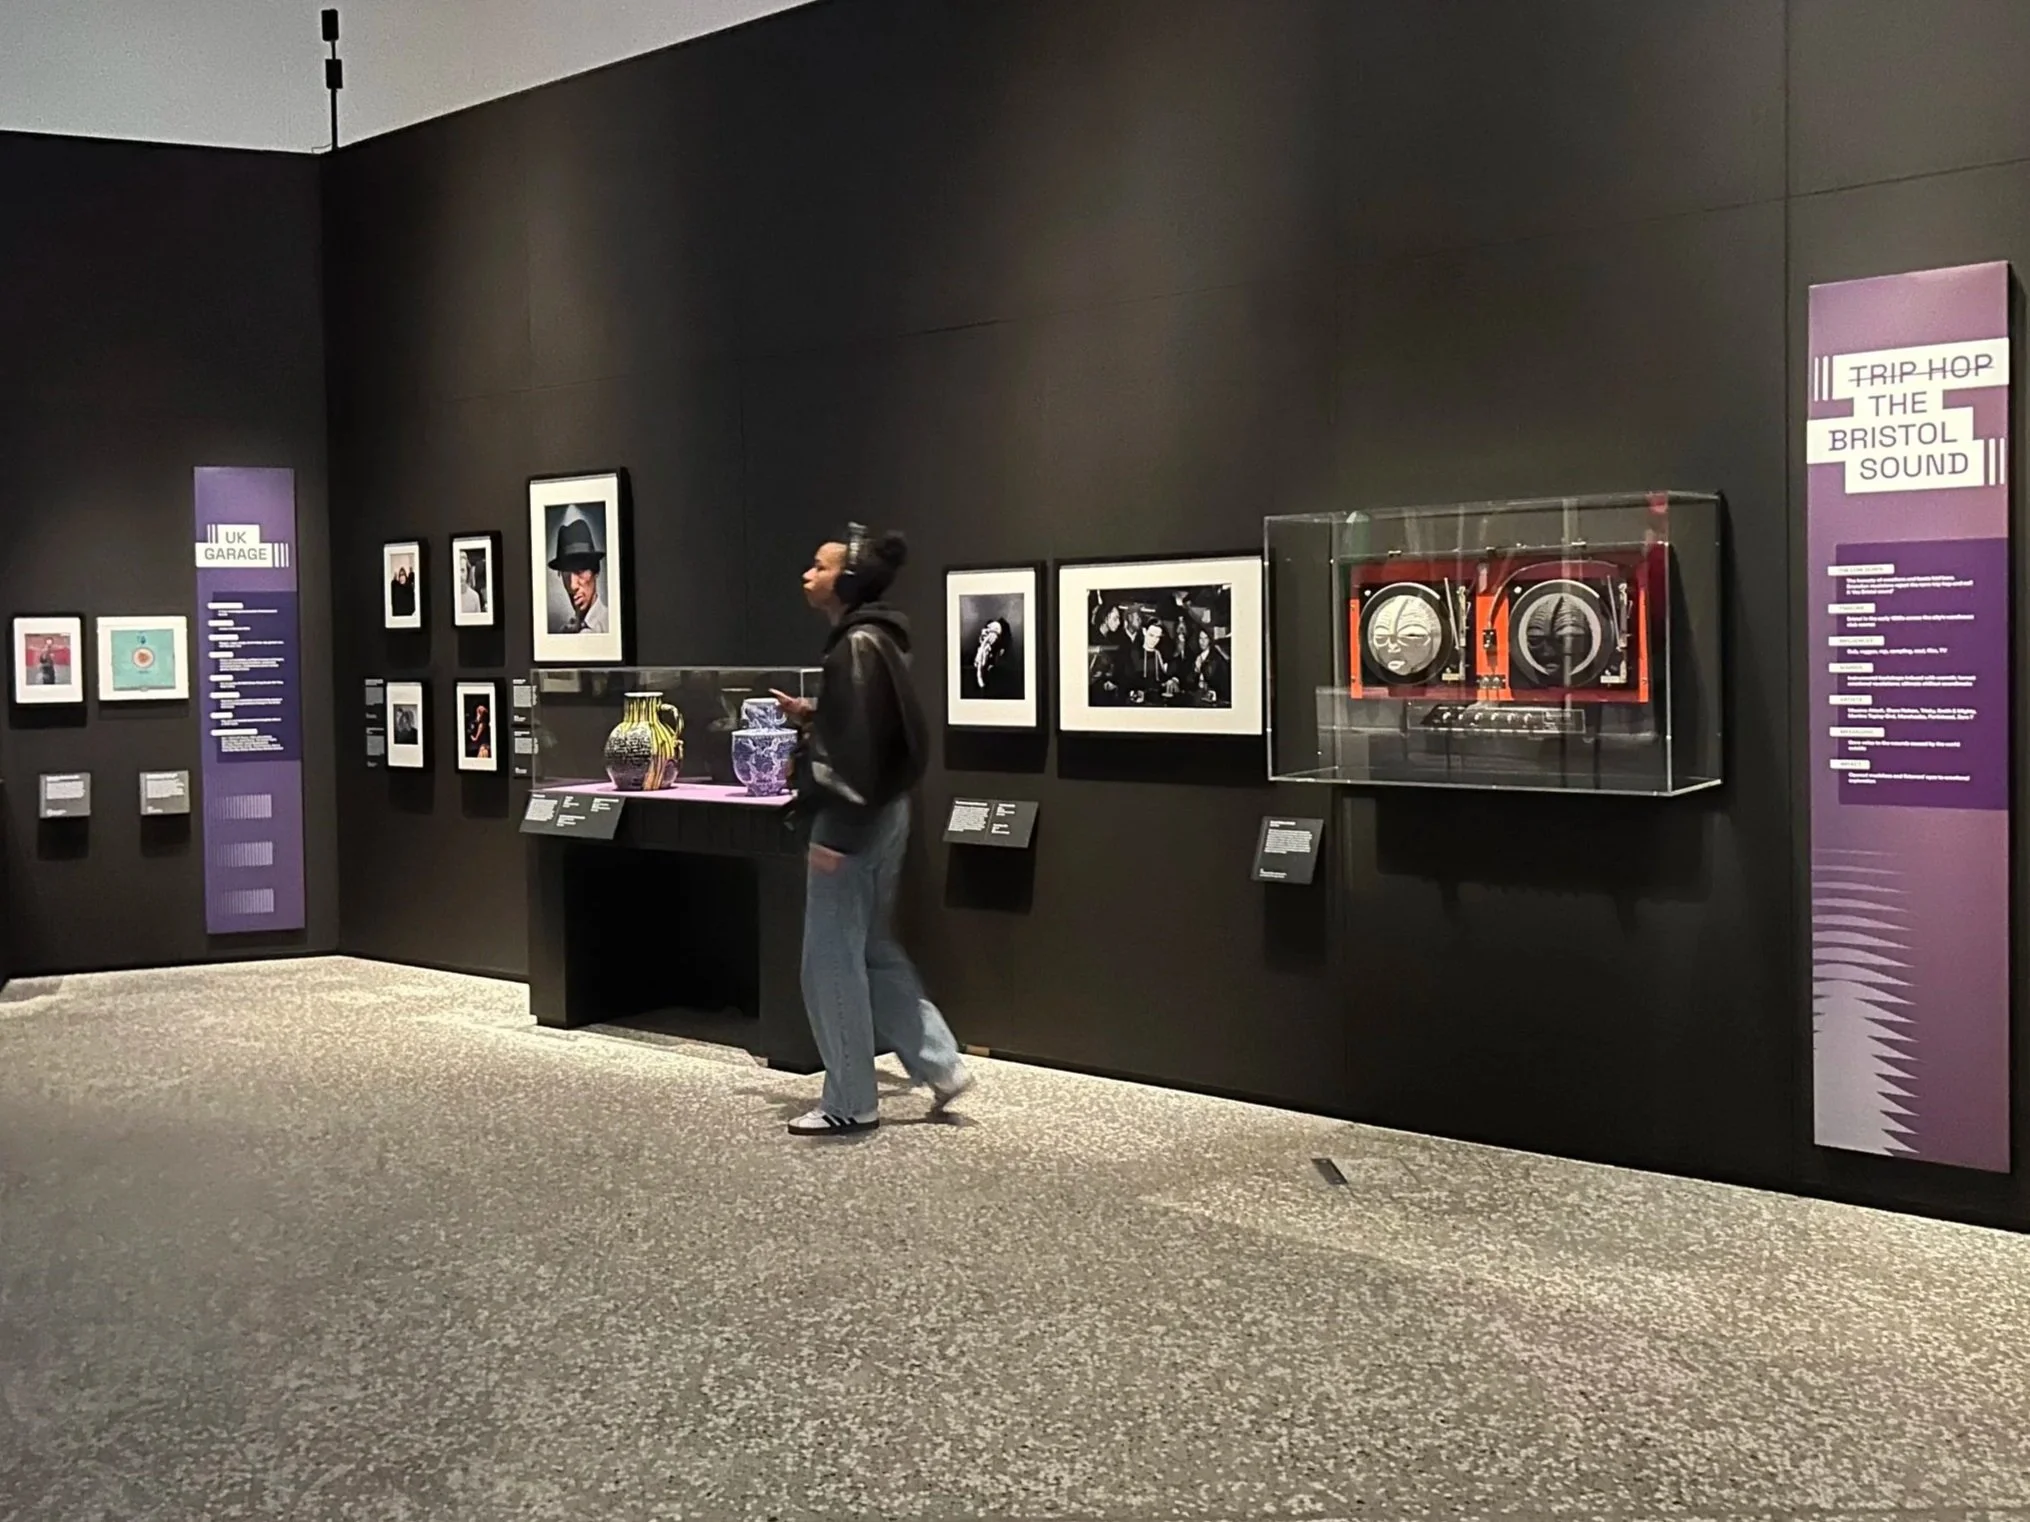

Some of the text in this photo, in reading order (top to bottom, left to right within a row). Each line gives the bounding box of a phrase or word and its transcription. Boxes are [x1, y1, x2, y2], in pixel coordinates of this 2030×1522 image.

[1849, 353, 1993, 388] TRIP HOP
[1868, 391, 1928, 417] THE
[1828, 421, 1958, 452] BRISTOL
[1859, 452, 1969, 480] SOUND
[225, 531, 247, 544] UK
[204, 548, 268, 560] GARAGE
